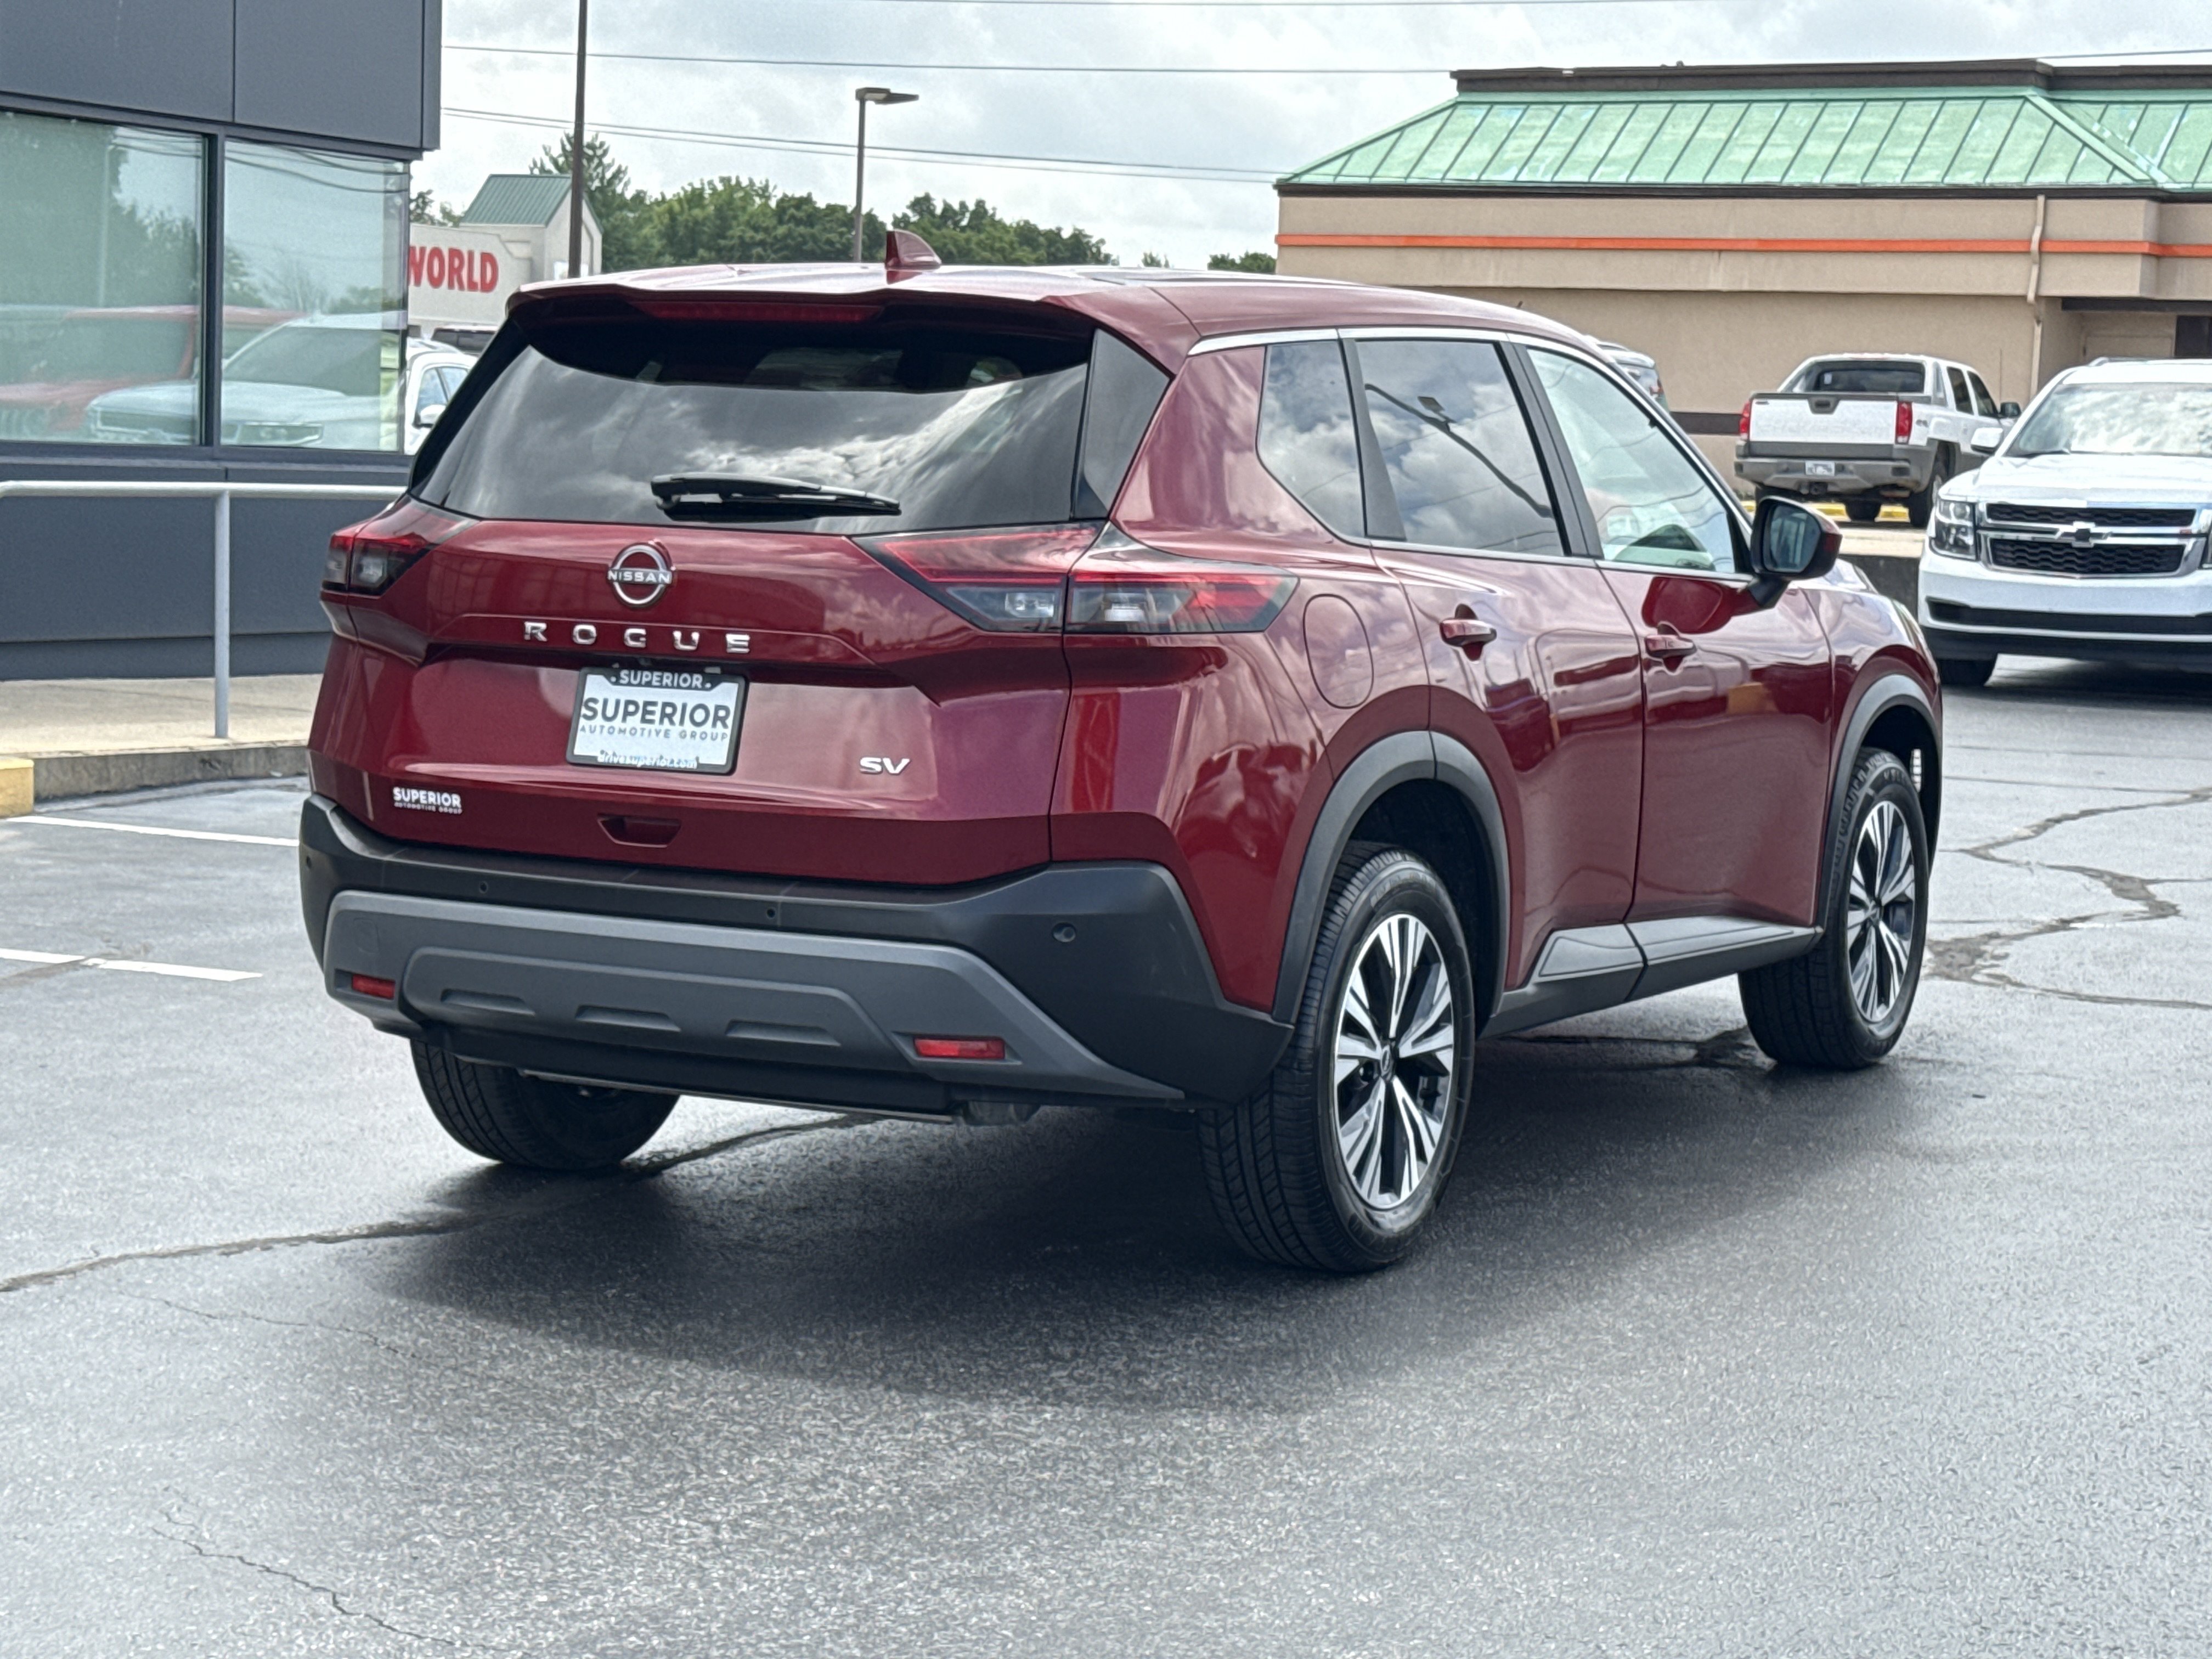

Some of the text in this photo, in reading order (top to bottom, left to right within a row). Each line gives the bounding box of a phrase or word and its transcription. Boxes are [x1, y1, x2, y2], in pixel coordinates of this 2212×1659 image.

[409, 246, 498, 292] WORLD
[607, 569, 671, 583] NISSAN
[524, 621, 750, 653] ROGUE
[619, 669, 703, 689] SUPERIOR
[582, 697, 730, 729] SUPERIOR
[580, 725, 727, 742] AUTOMOTIVE GROUP
[860, 757, 911, 774] SV
[393, 787, 461, 808] SUPERIOR
